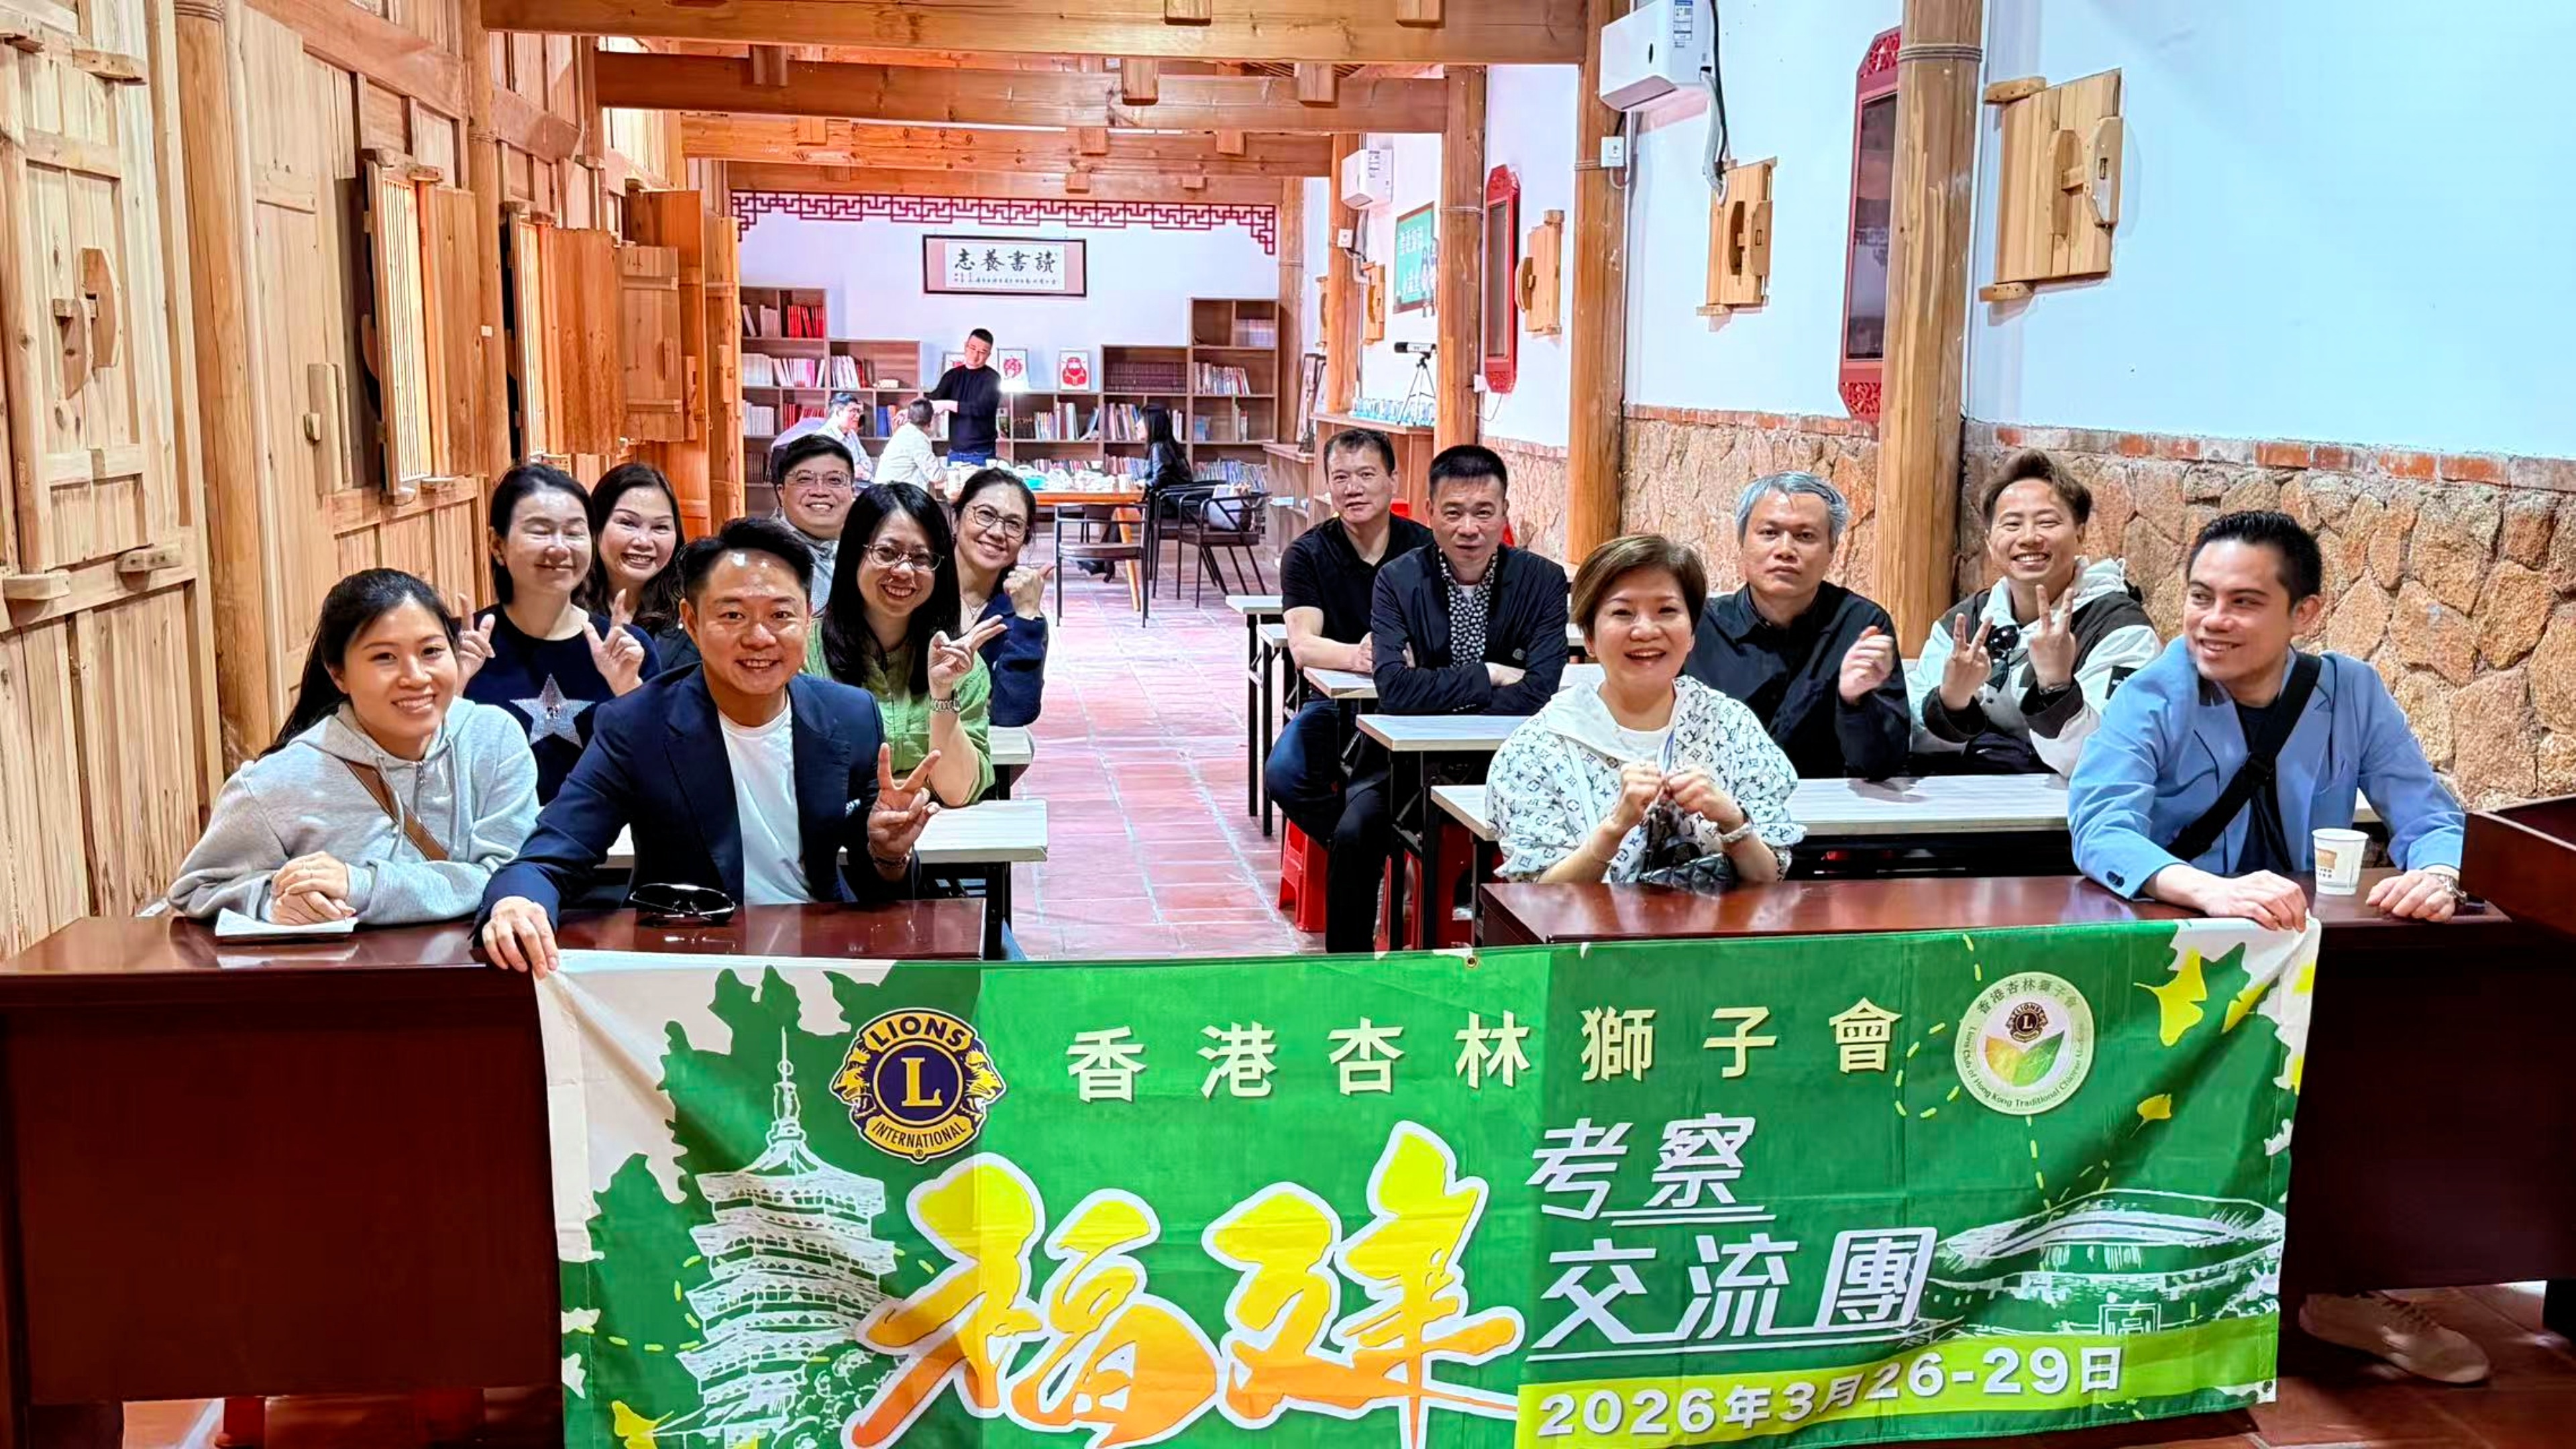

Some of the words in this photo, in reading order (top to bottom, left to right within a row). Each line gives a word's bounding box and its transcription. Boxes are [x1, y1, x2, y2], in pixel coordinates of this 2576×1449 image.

[869, 1016, 967, 1047] LIONS
[1067, 997, 1902, 1104] 香港杏林獅子會
[2022, 1015, 2033, 1030] L
[901, 1057, 943, 1107] L
[1968, 1069, 1978, 1079] of
[1974, 1078, 1992, 1098] Hong
[1990, 1092, 2012, 1108] Kong
[871, 1121, 967, 1148] INTERNATIONAL
[1525, 1112, 1756, 1220] 考察
[841, 1120, 1524, 1449] 福建
[1530, 1226, 1938, 1349] 交流團
[1537, 1346, 2123, 1437] 2026年3月26-29日
